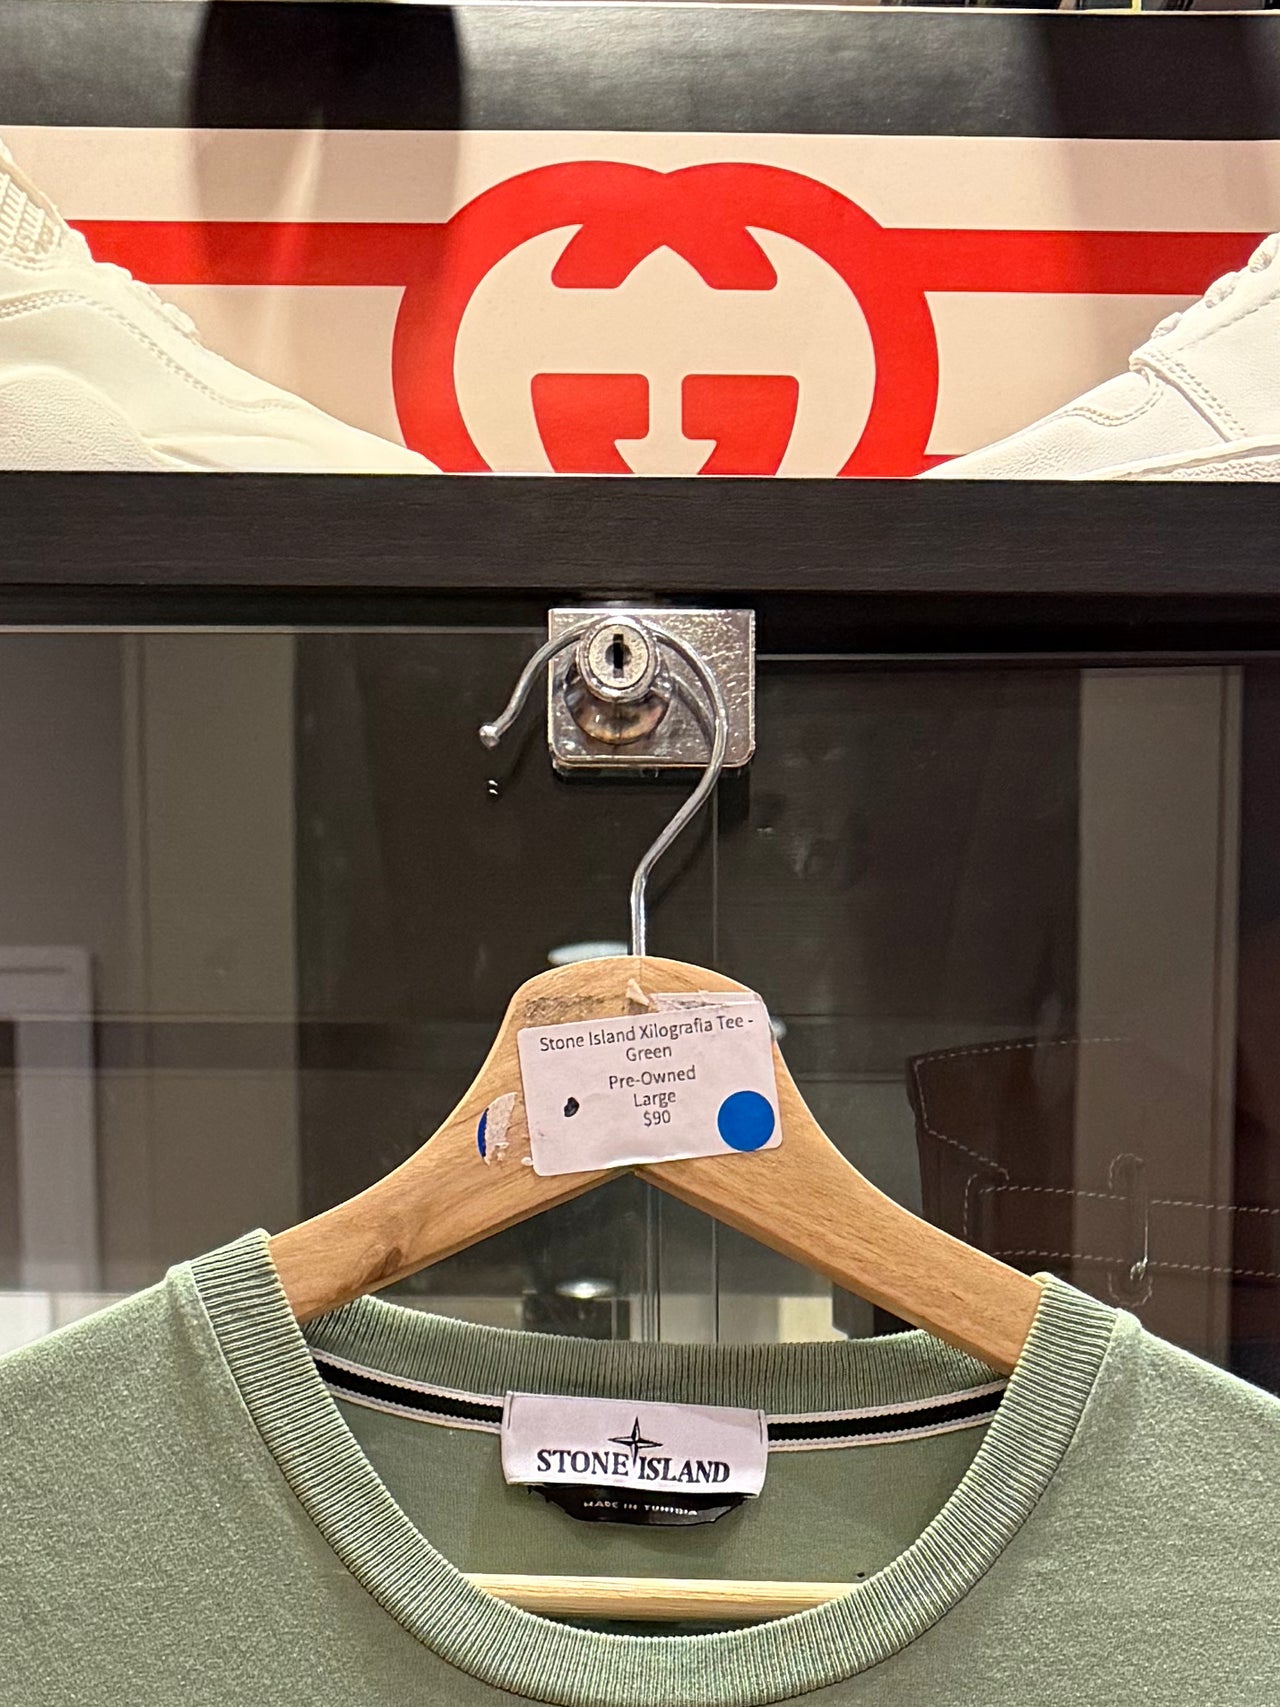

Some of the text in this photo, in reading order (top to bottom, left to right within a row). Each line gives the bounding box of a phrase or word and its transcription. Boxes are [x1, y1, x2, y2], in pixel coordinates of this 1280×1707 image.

[540, 1036, 585, 1052] Stone
[588, 1026, 636, 1046] Island
[639, 1017, 713, 1043] Xilografia
[716, 1014, 744, 1031] Tee
[626, 1045, 672, 1062] Green
[608, 1065, 696, 1090] Pre-Owned
[633, 1091, 677, 1109] Large
[643, 1110, 671, 1128] $90
[536, 1449, 731, 1484] STONE ISLAND
